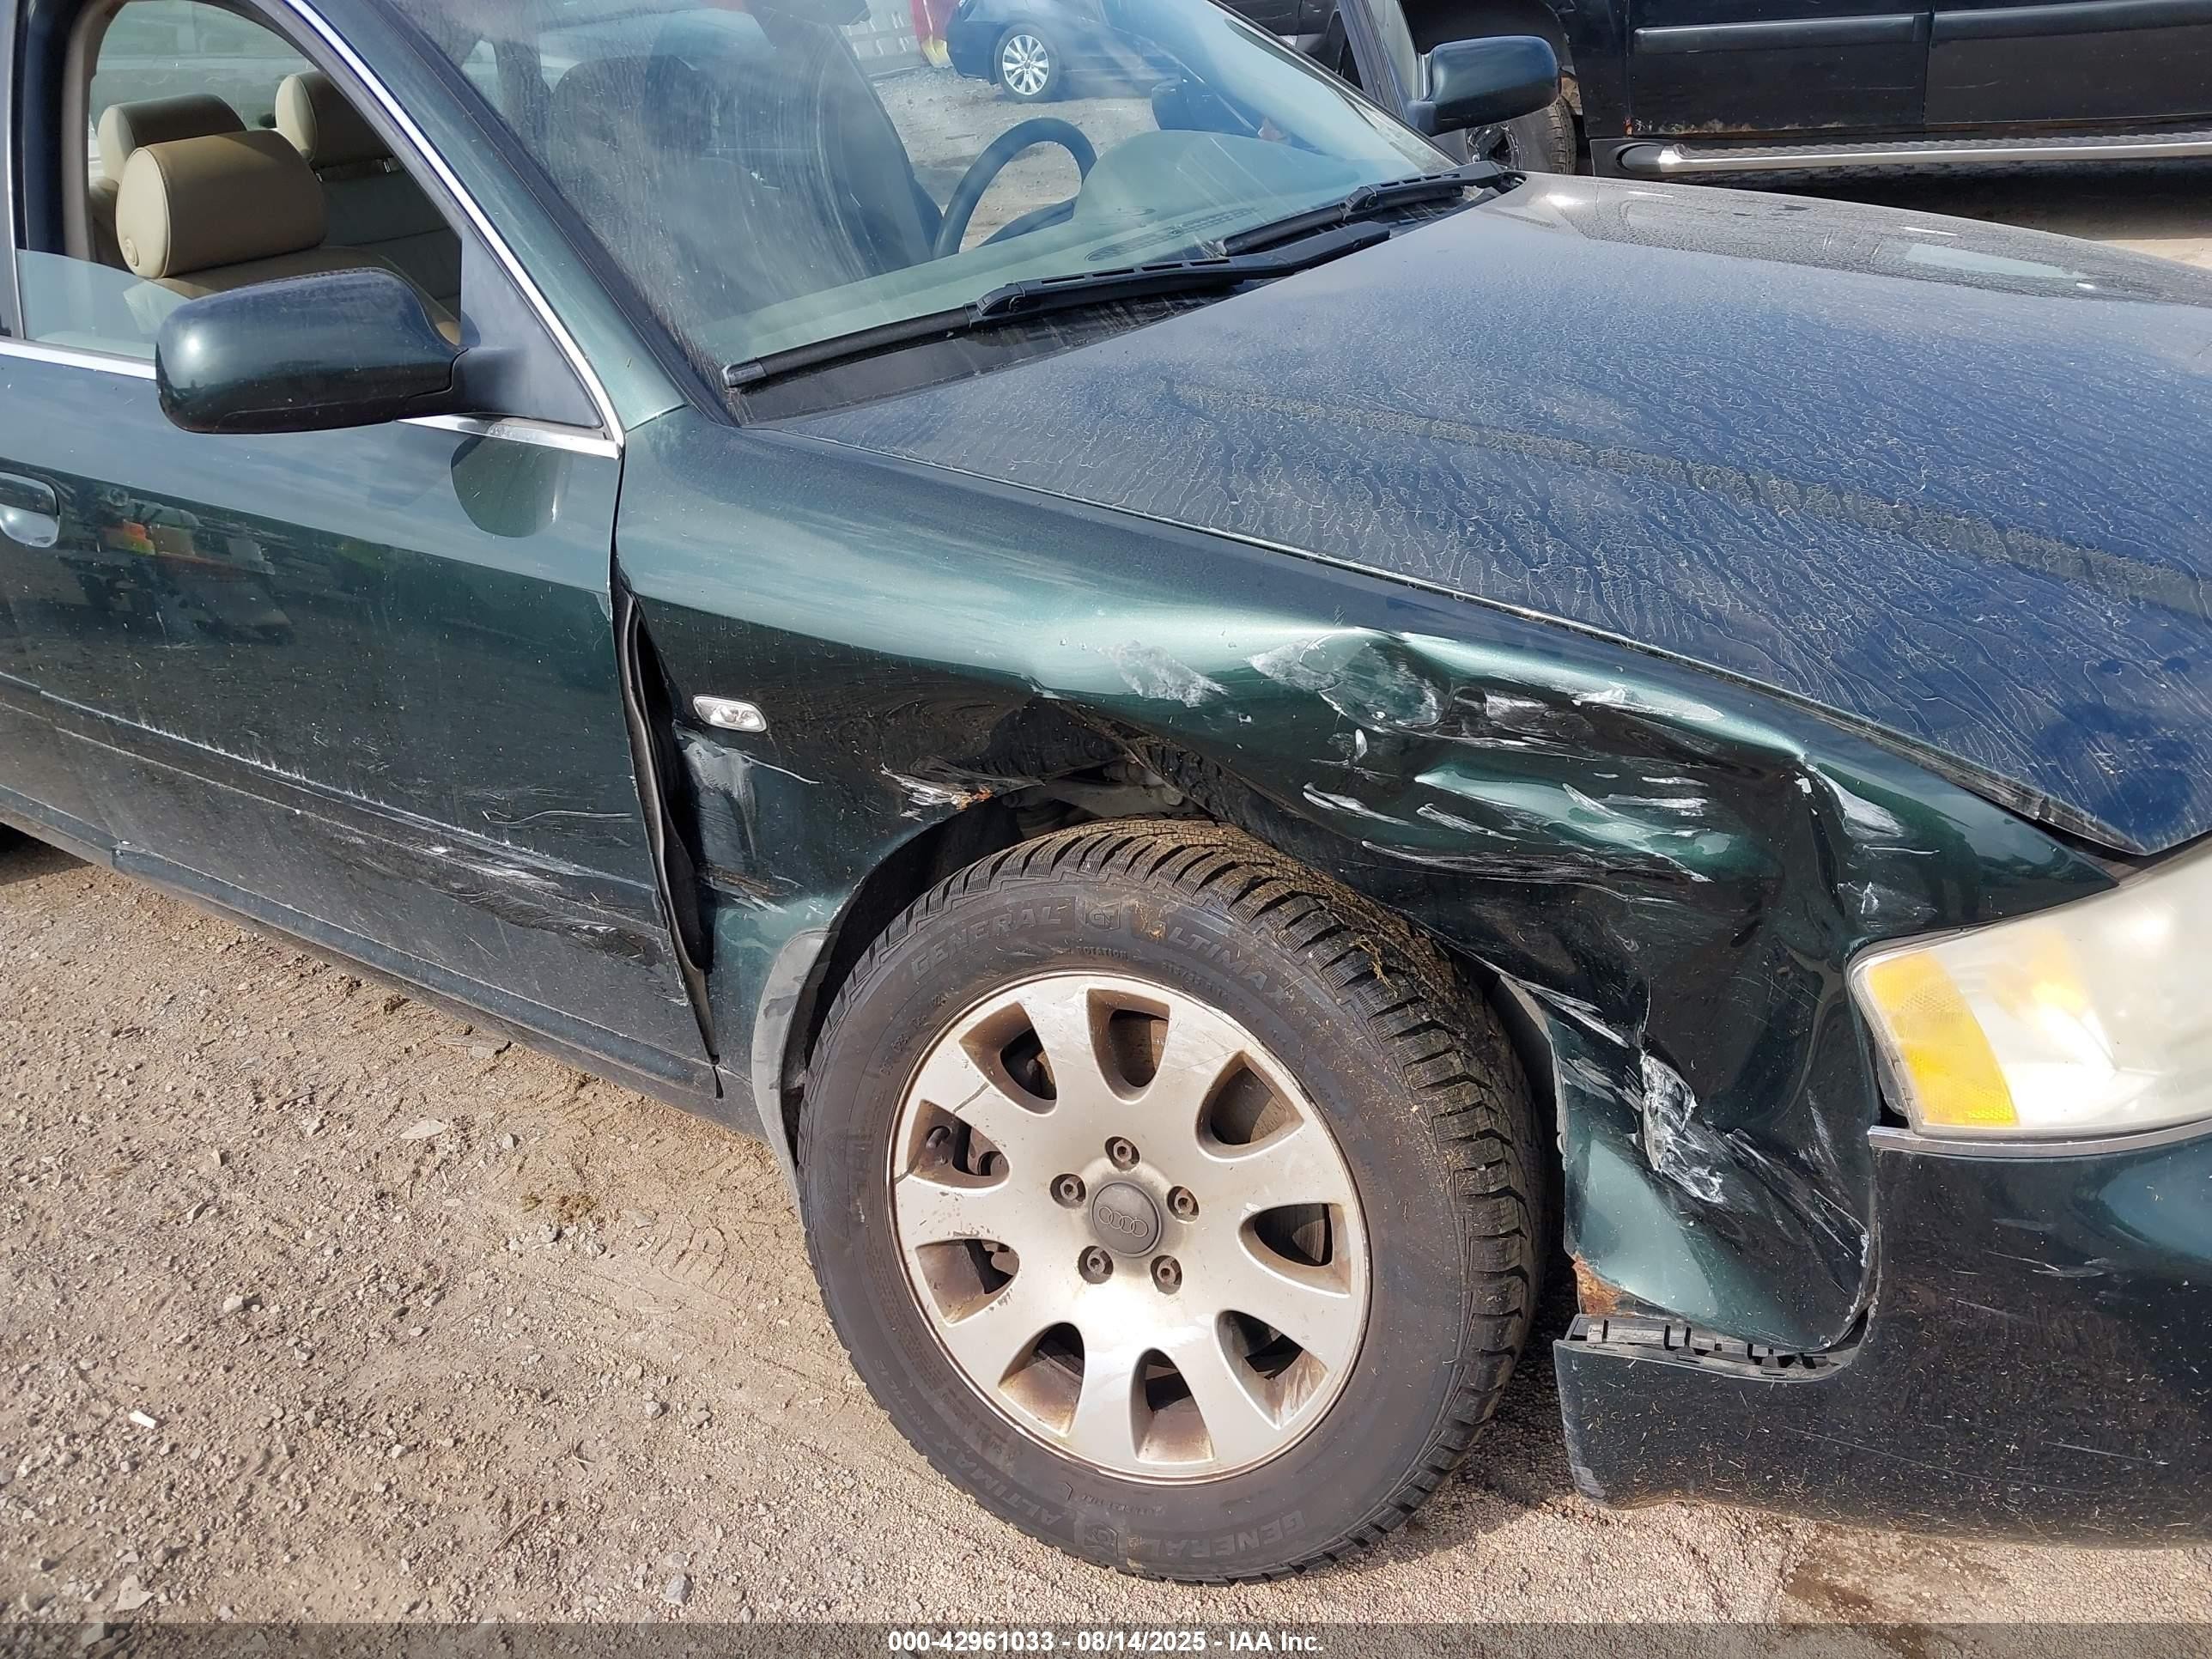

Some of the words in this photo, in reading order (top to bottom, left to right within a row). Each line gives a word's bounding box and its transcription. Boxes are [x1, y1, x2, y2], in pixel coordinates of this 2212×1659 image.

[910, 905, 1062, 977] GENERAL
[1076, 945, 1128, 960] ROTATION
[886, 1379, 935, 1435] ARCTIC
[933, 1439, 1063, 1526] ALTIMAX
[1144, 1509, 1306, 1559] GENERAL
